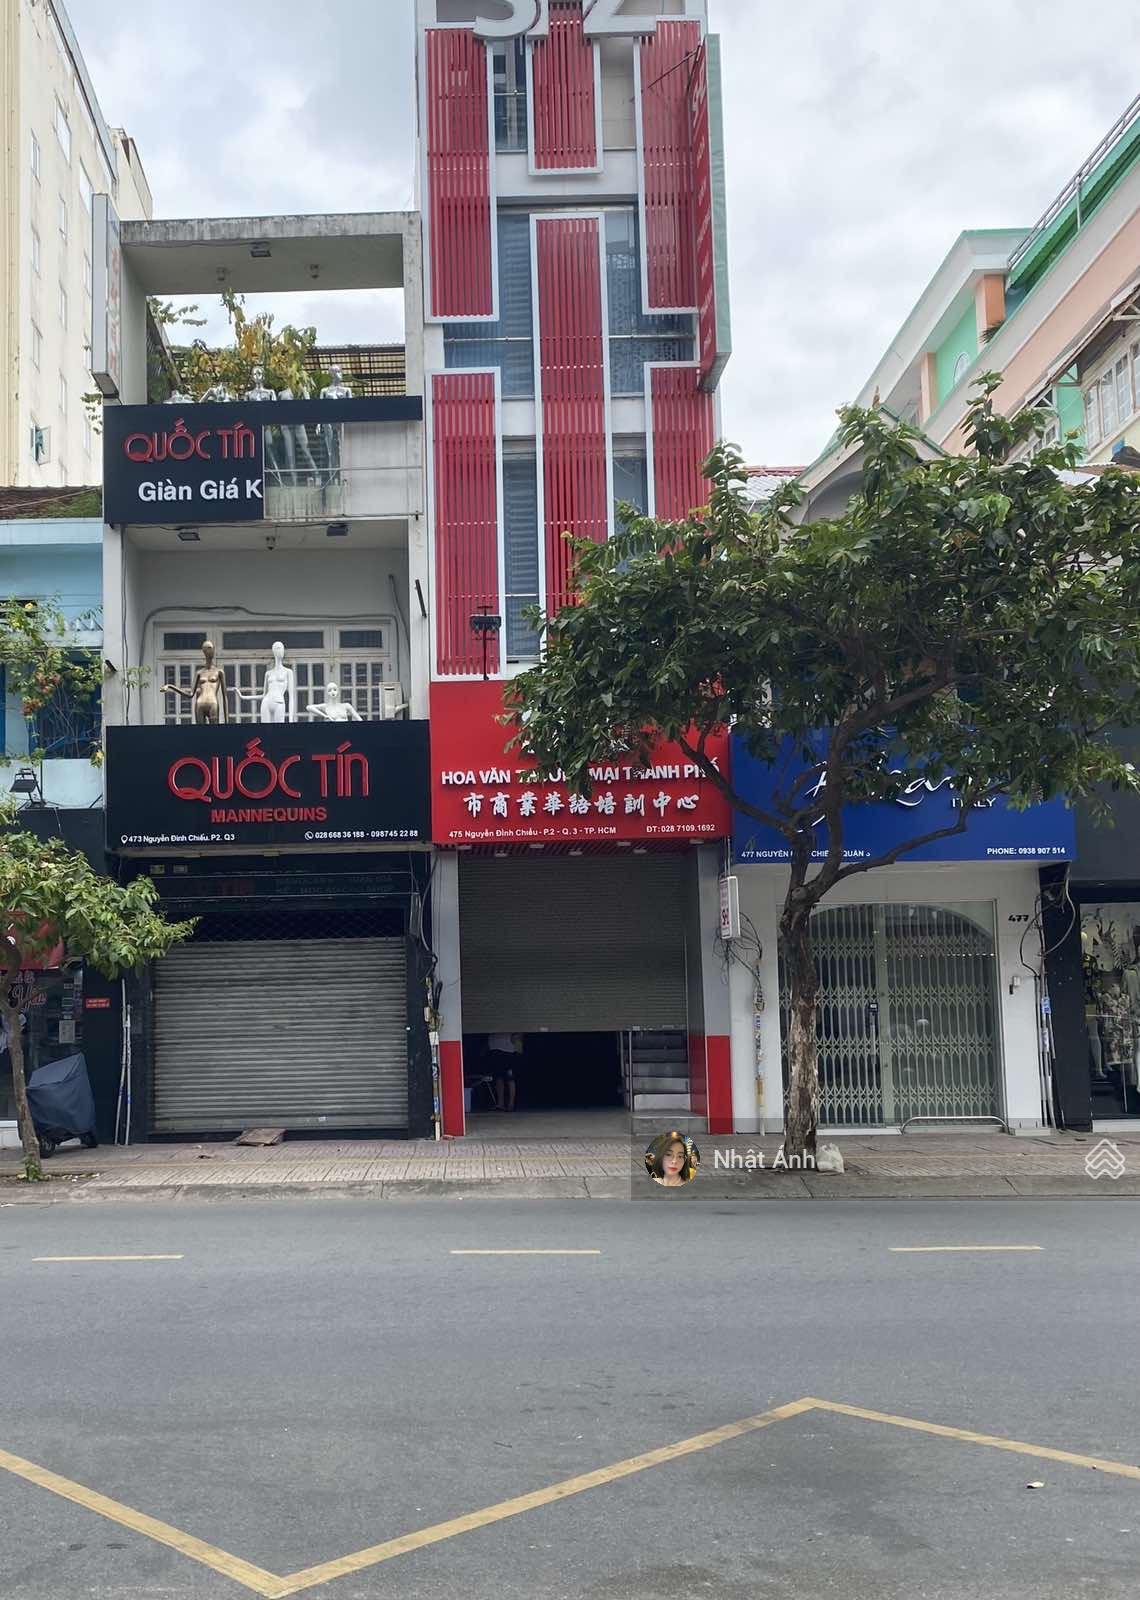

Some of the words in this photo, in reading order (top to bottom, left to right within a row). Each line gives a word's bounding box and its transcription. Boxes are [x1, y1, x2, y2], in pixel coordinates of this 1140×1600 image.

[123, 416, 210, 463] QUỐC
[138, 478, 192, 501] Giàn
[200, 477, 239, 500] Giá
[167, 736, 301, 803] QUỐC
[441, 770, 476, 785] HOA
[479, 766, 511, 784] VĂN
[588, 766, 620, 785] MẠI
[211, 806, 328, 823] MANNEQUINS
[314, 831, 328, 839] 028
[597, 826, 617, 834] HCM
[987, 847, 1017, 855] PHONE:
[1008, 914, 1029, 922] 477
